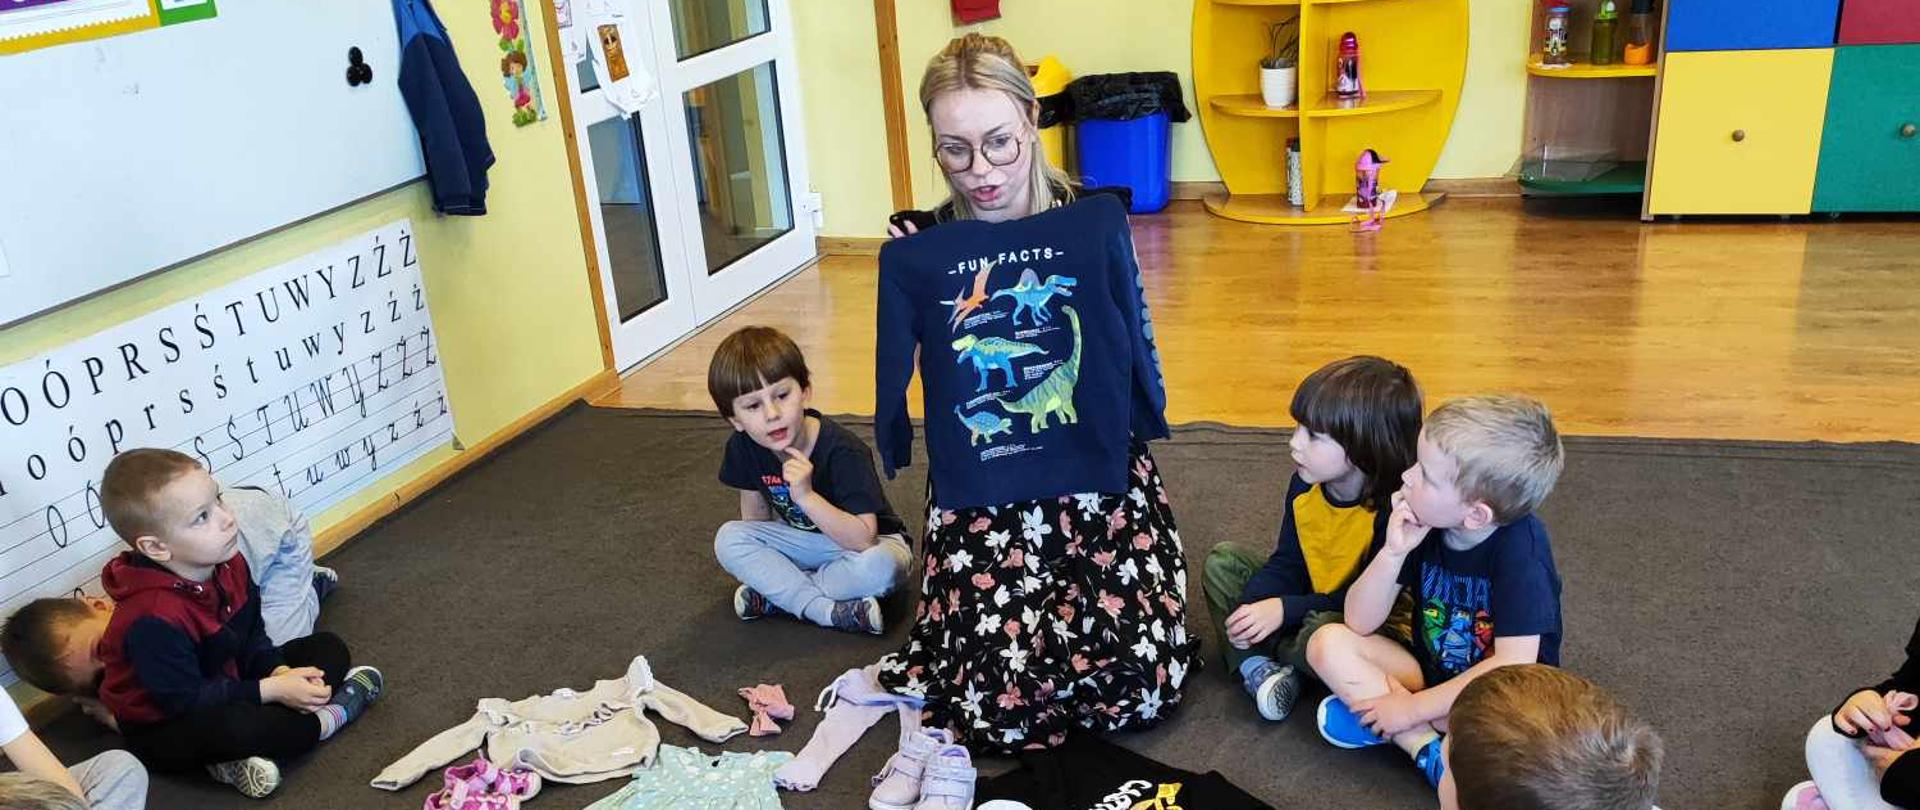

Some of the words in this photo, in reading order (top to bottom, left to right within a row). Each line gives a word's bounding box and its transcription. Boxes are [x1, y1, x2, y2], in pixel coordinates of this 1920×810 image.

[1, 387, 29, 425] O
[42, 359, 70, 408] Ó
[83, 356, 104, 394] P
[118, 342, 149, 381] R
[159, 327, 180, 363] S
[194, 303, 215, 350] Ś
[226, 301, 249, 337] T
[256, 288, 281, 323] U
[283, 274, 310, 311] W
[315, 265, 337, 299] Y
[347, 254, 365, 289] Z
